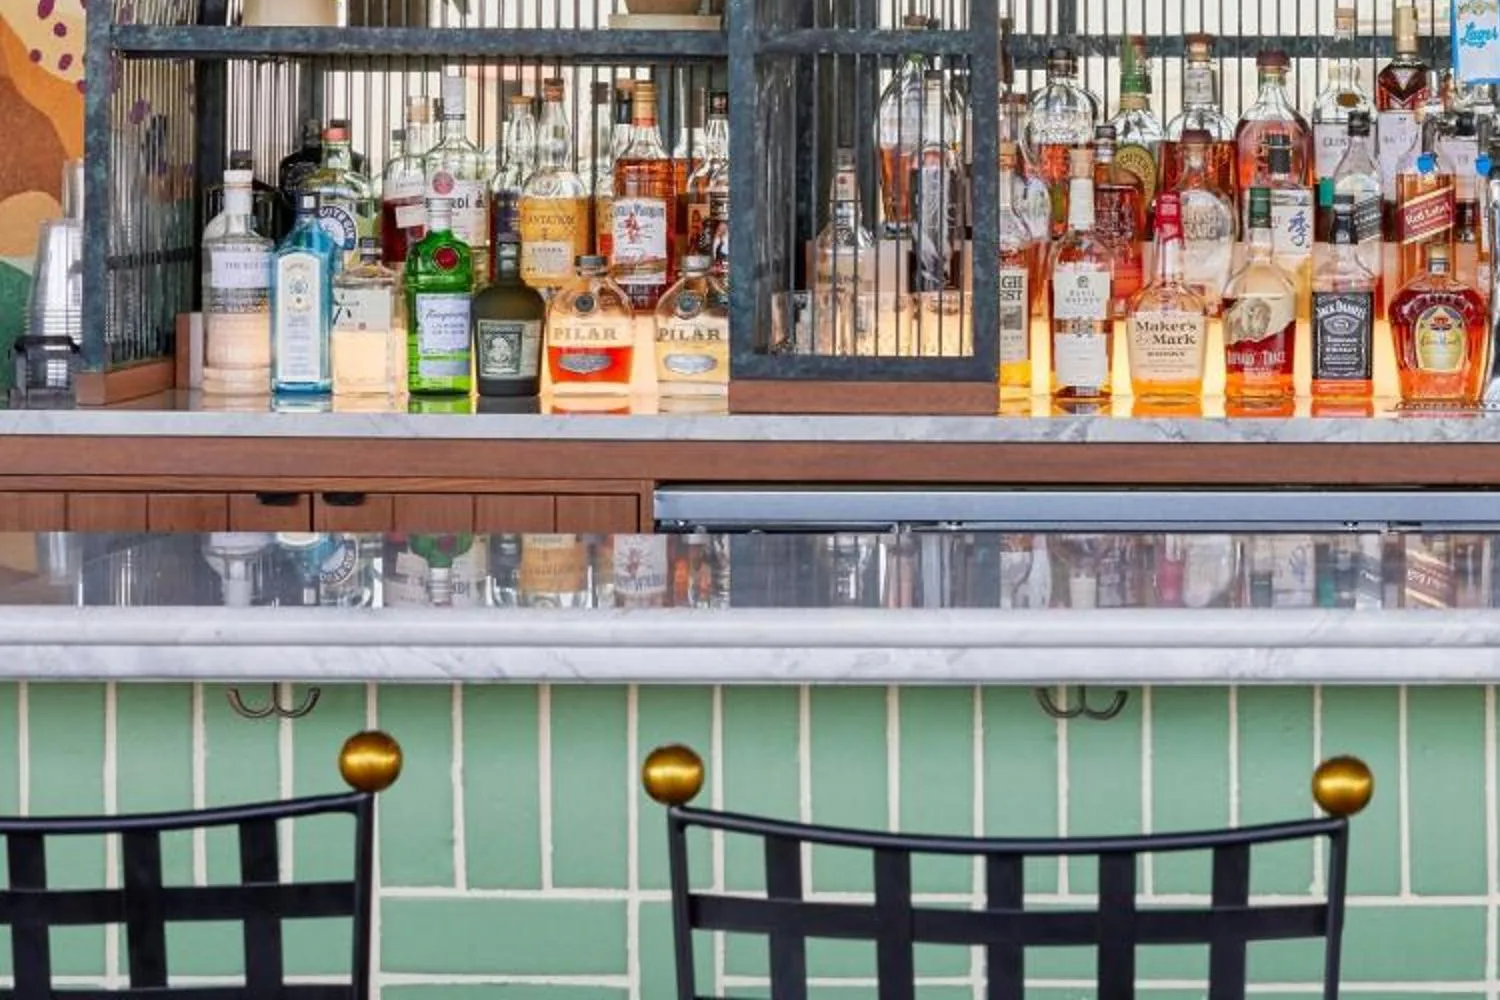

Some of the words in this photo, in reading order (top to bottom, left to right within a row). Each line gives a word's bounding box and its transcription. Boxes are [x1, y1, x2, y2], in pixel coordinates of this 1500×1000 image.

[1405, 211, 1425, 225] Red
[1001, 275, 1024, 289] GH
[999, 289, 1023, 301] EST
[1136, 320, 1197, 332] Maker's
[553, 327, 617, 341] PILAR
[657, 327, 721, 342] PILAR
[1152, 333, 1197, 344] Mark
